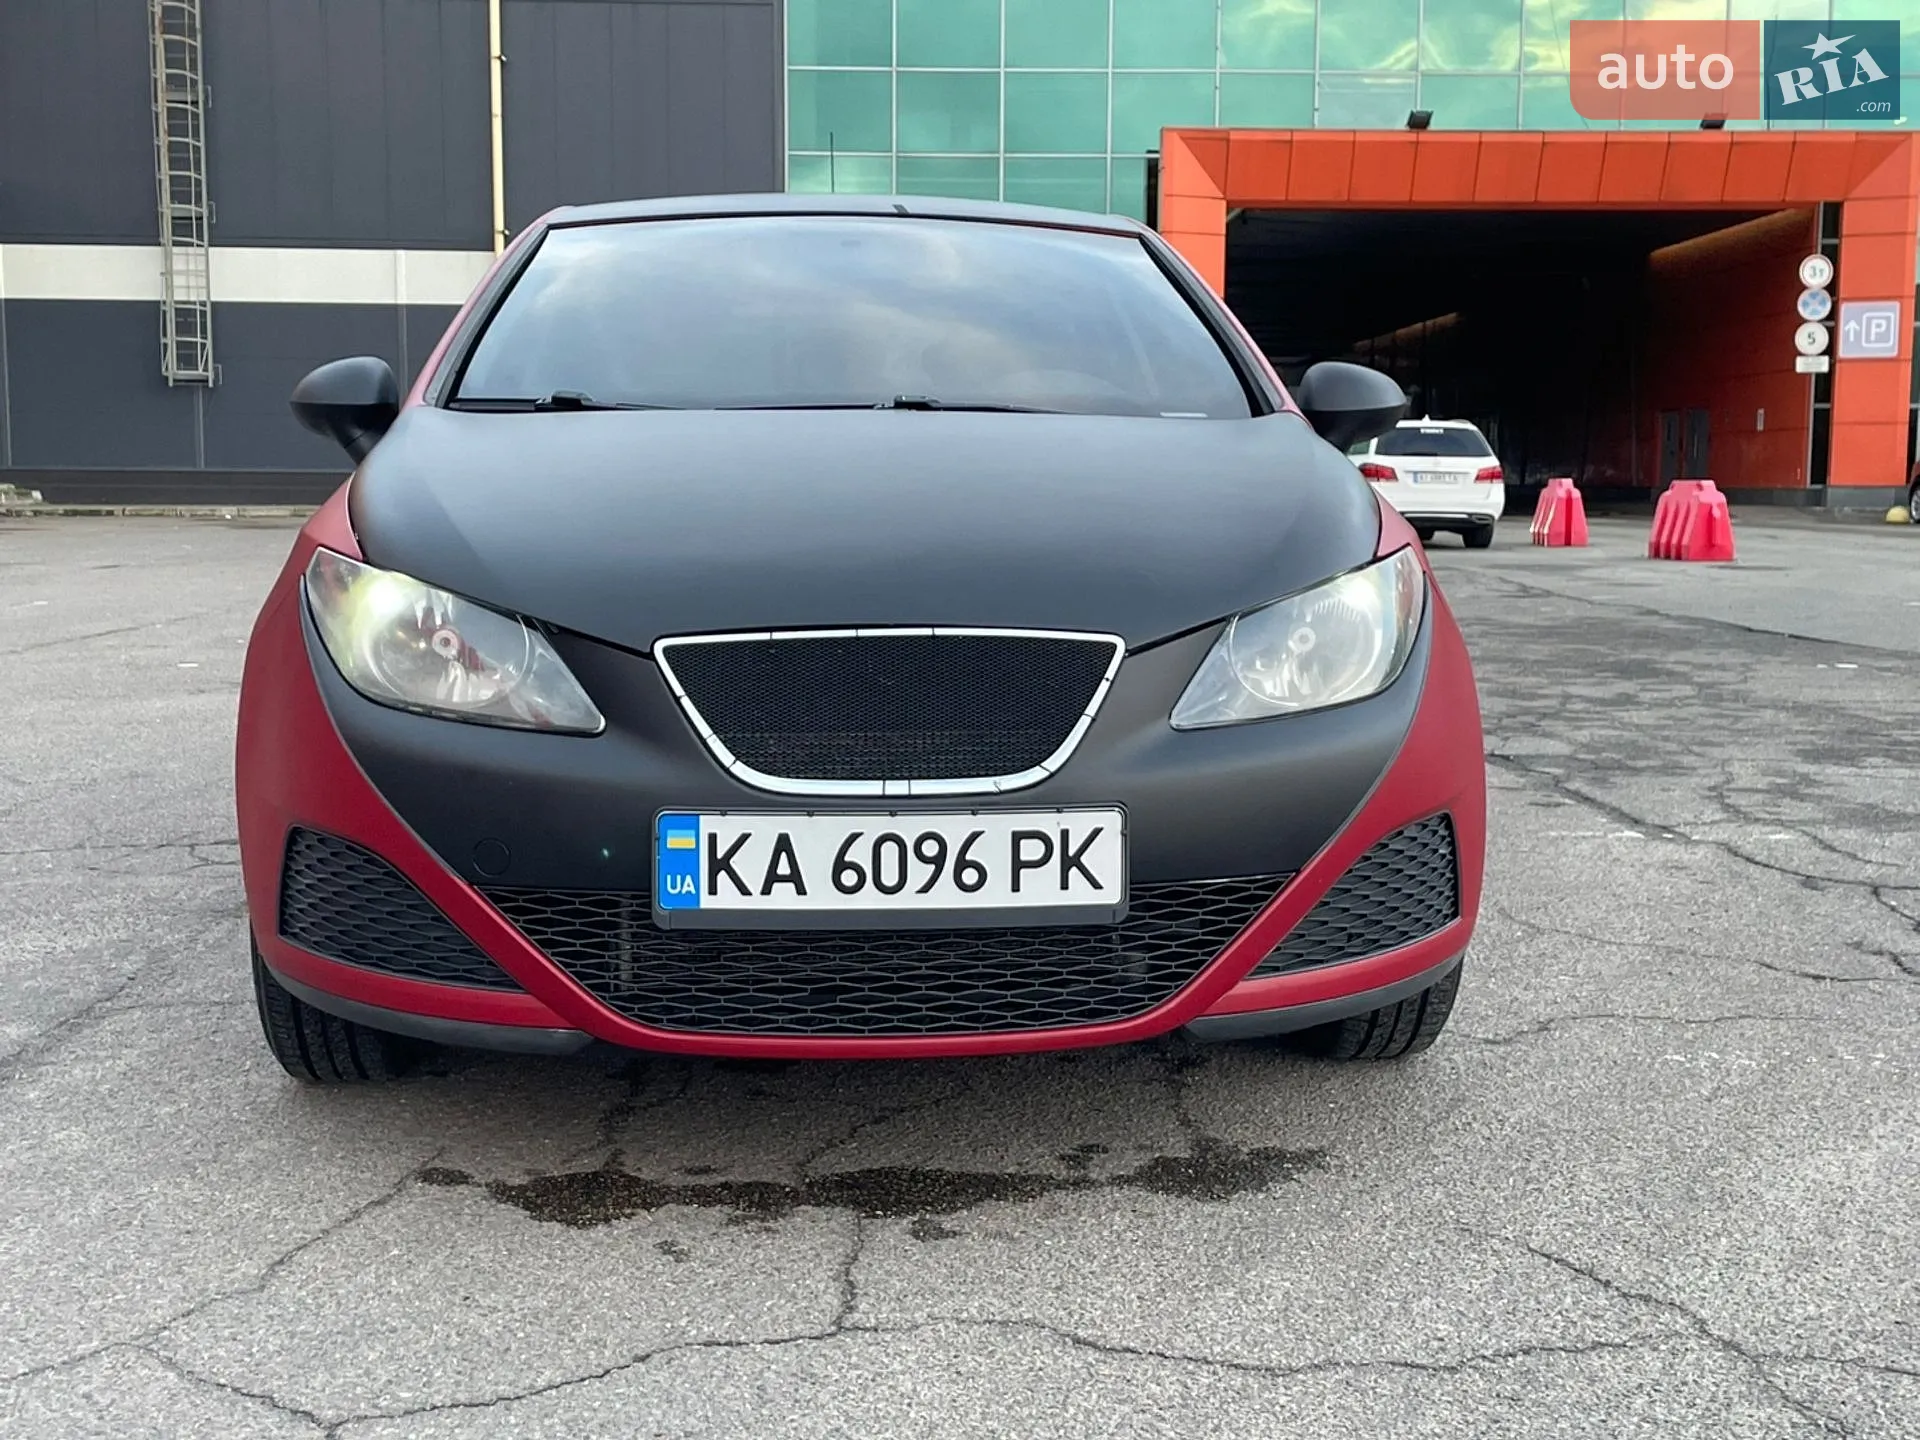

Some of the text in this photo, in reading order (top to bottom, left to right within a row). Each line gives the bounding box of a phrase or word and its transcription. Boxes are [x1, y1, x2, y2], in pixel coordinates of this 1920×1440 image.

[1807, 331, 1816, 345] 5
[1870, 319, 1887, 341] P
[707, 827, 1105, 897] KA 6096 PK
[666, 874, 697, 895] UA
